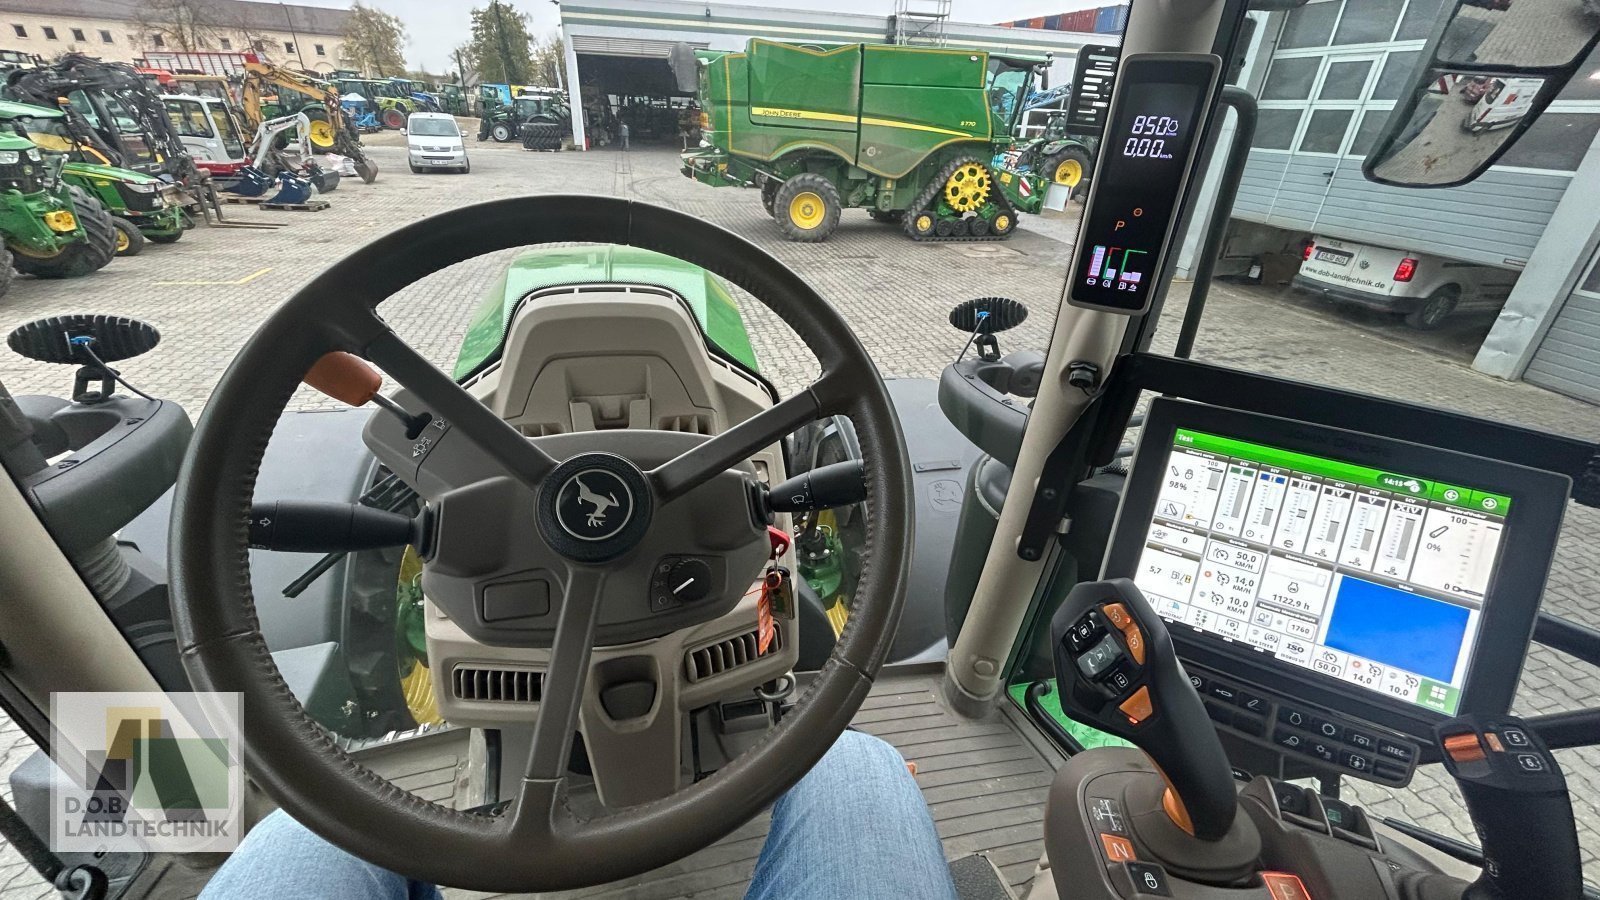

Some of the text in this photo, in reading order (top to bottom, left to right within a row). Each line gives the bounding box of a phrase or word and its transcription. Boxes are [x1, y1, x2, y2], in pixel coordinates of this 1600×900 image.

[780, 110, 801, 118] DEERE
[1131, 115, 1171, 136] 850
[1123, 137, 1164, 158] 0,00
[1114, 220, 1125, 231] P
[1305, 265, 1385, 289] www.dob-landtechnik.de
[1178, 433, 1194, 443] Test
[1169, 480, 1188, 491] 98%
[1450, 515, 1468, 526] 100
[1426, 542, 1441, 552] 0%
[1236, 551, 1257, 563] 50,0
[1149, 565, 1162, 575] 5,7
[1234, 560, 1254, 570] KM/H
[1234, 576, 1255, 588] 14,0
[1232, 584, 1252, 595] KM/H
[1229, 596, 1249, 608] 10,0
[1226, 606, 1246, 616] KM/H
[1291, 624, 1310, 635] 1760
[1286, 643, 1305, 653] ISO
[1512, 734, 1521, 743] 5
[1112, 842, 1129, 859] N
